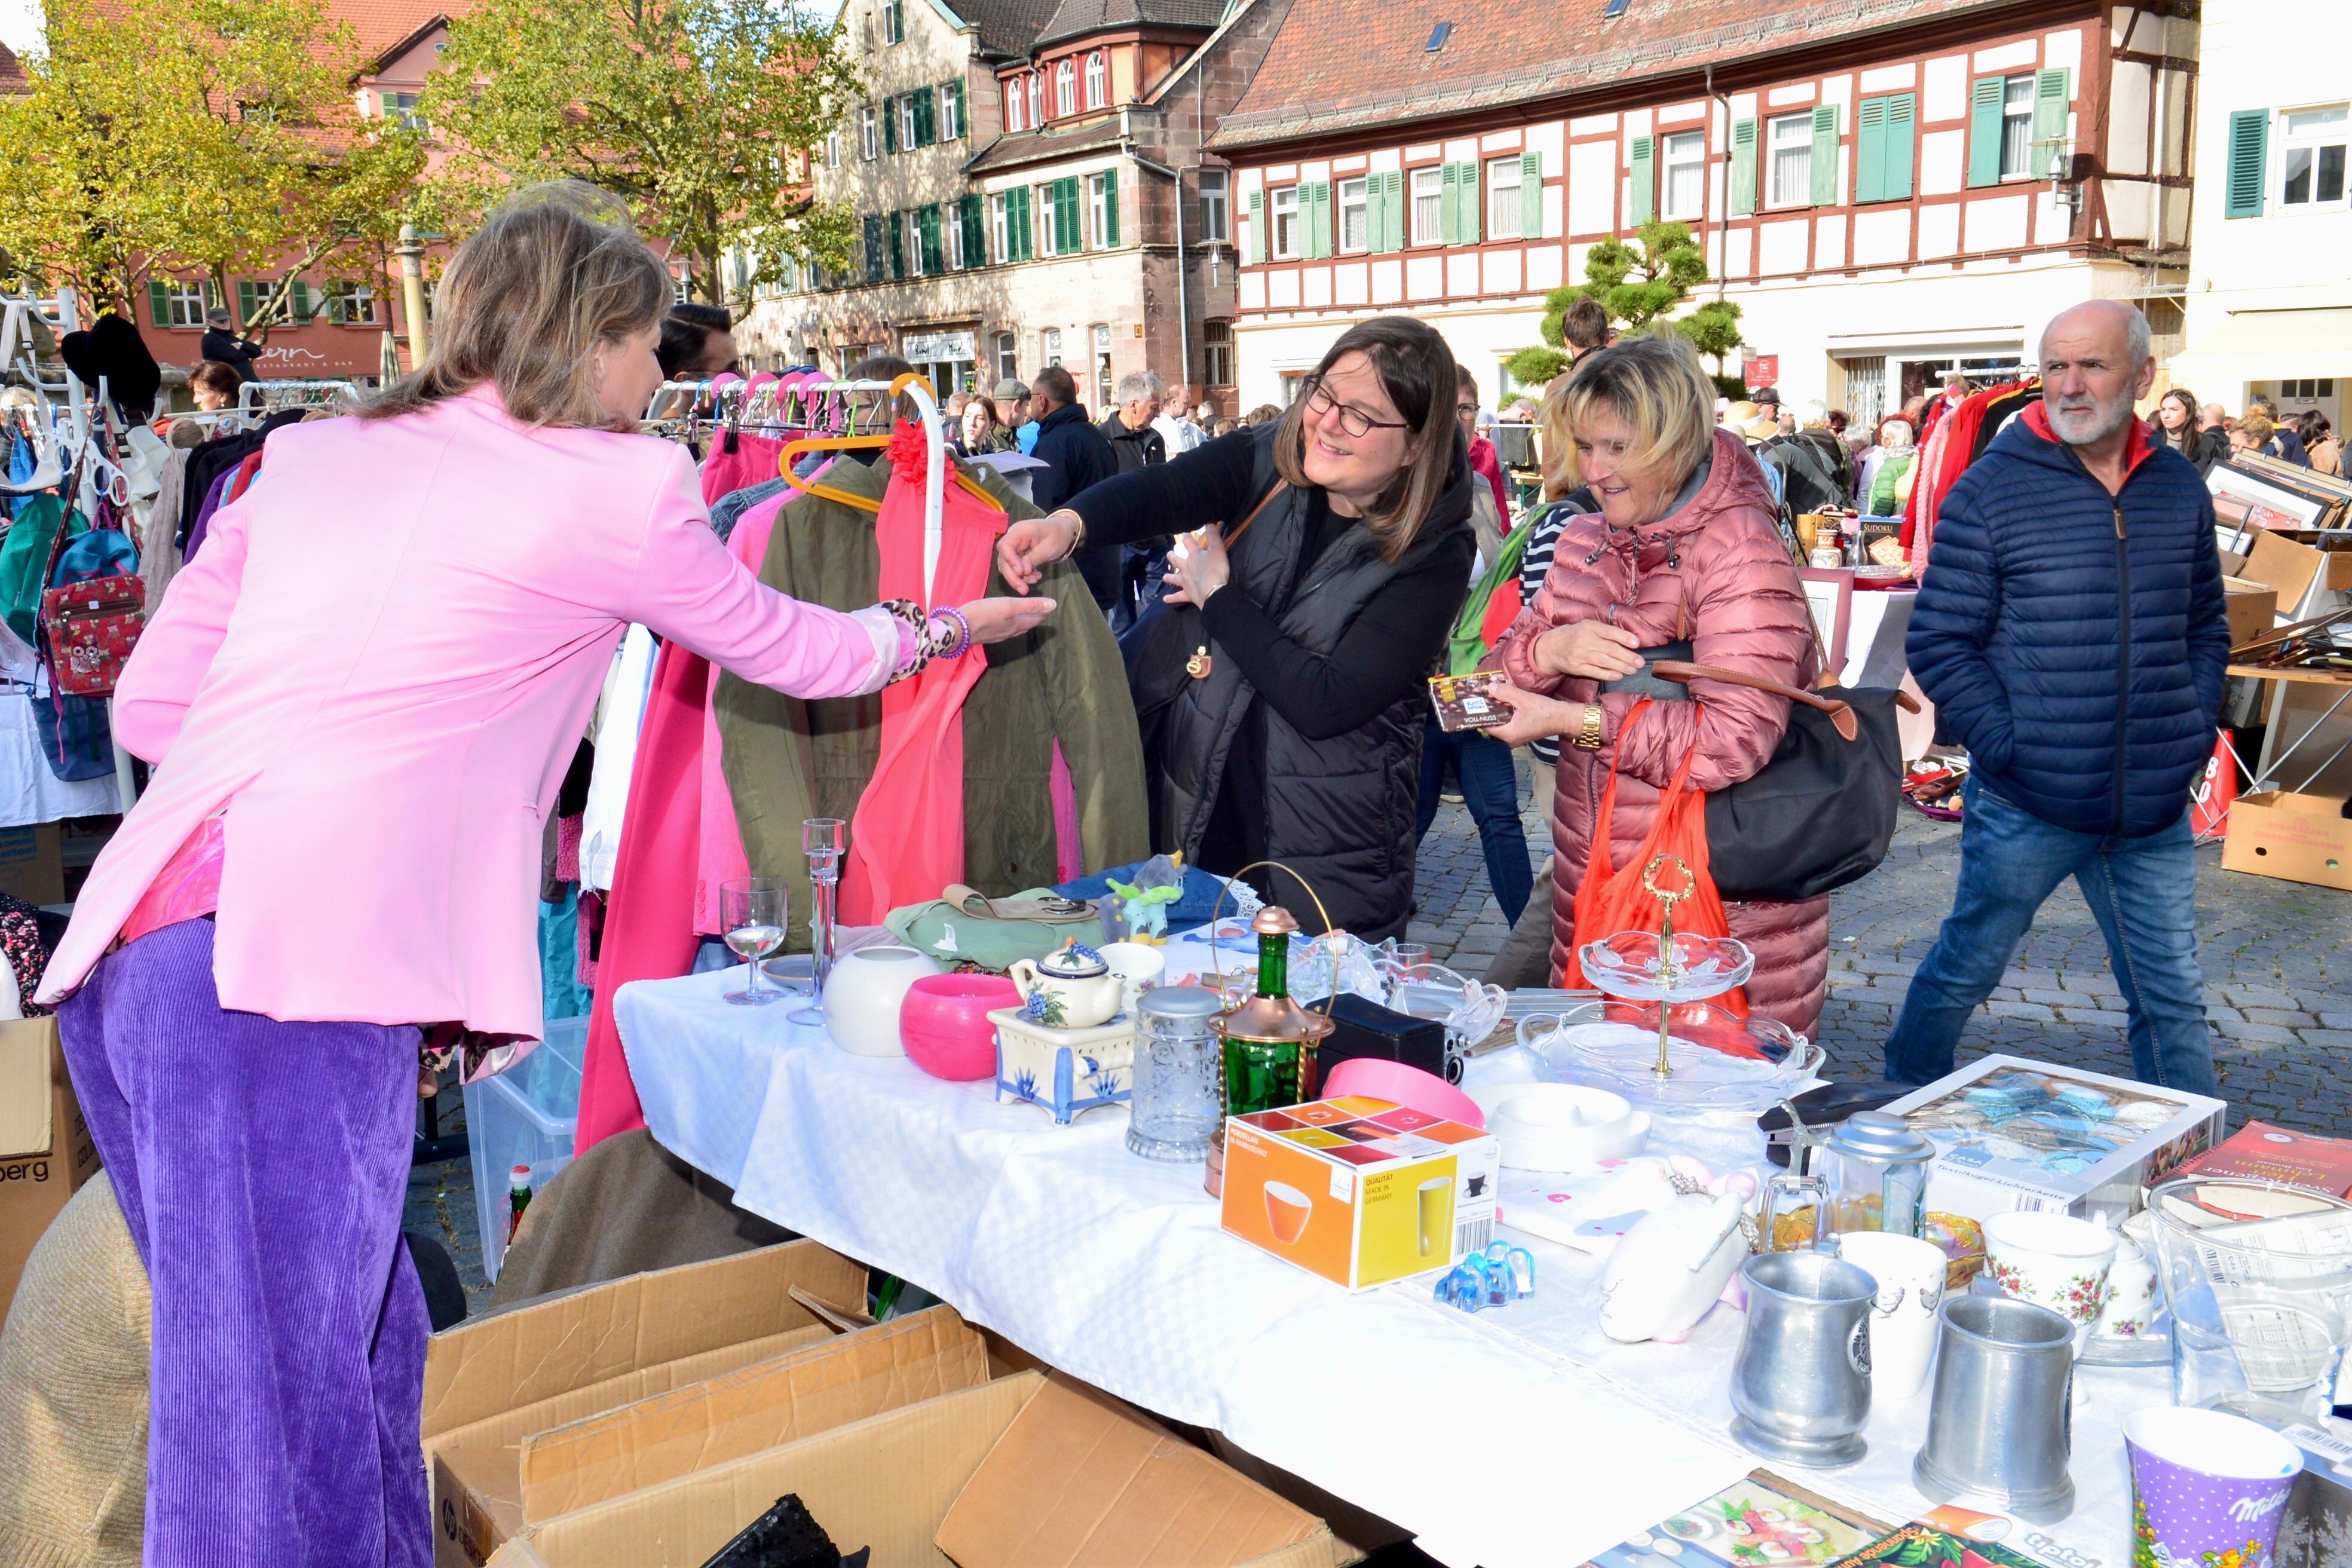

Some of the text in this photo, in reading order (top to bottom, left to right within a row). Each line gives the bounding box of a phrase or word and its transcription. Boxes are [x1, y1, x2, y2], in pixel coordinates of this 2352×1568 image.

[256, 347, 325, 362] ern
[1863, 523, 1893, 532] SUDOKU
[1230, 1128, 1259, 1144] PORZELLAN
[1949, 1153, 1982, 1165] CASA
[2257, 1160, 2292, 1169] Roman
[1365, 1173, 1394, 1186] QUALITÄT
[1937, 1164, 2066, 1200] Textilkugel-Lichterkette
[1365, 1193, 1393, 1205] GERMANY
[1858, 1527, 1920, 1560] Spannende
